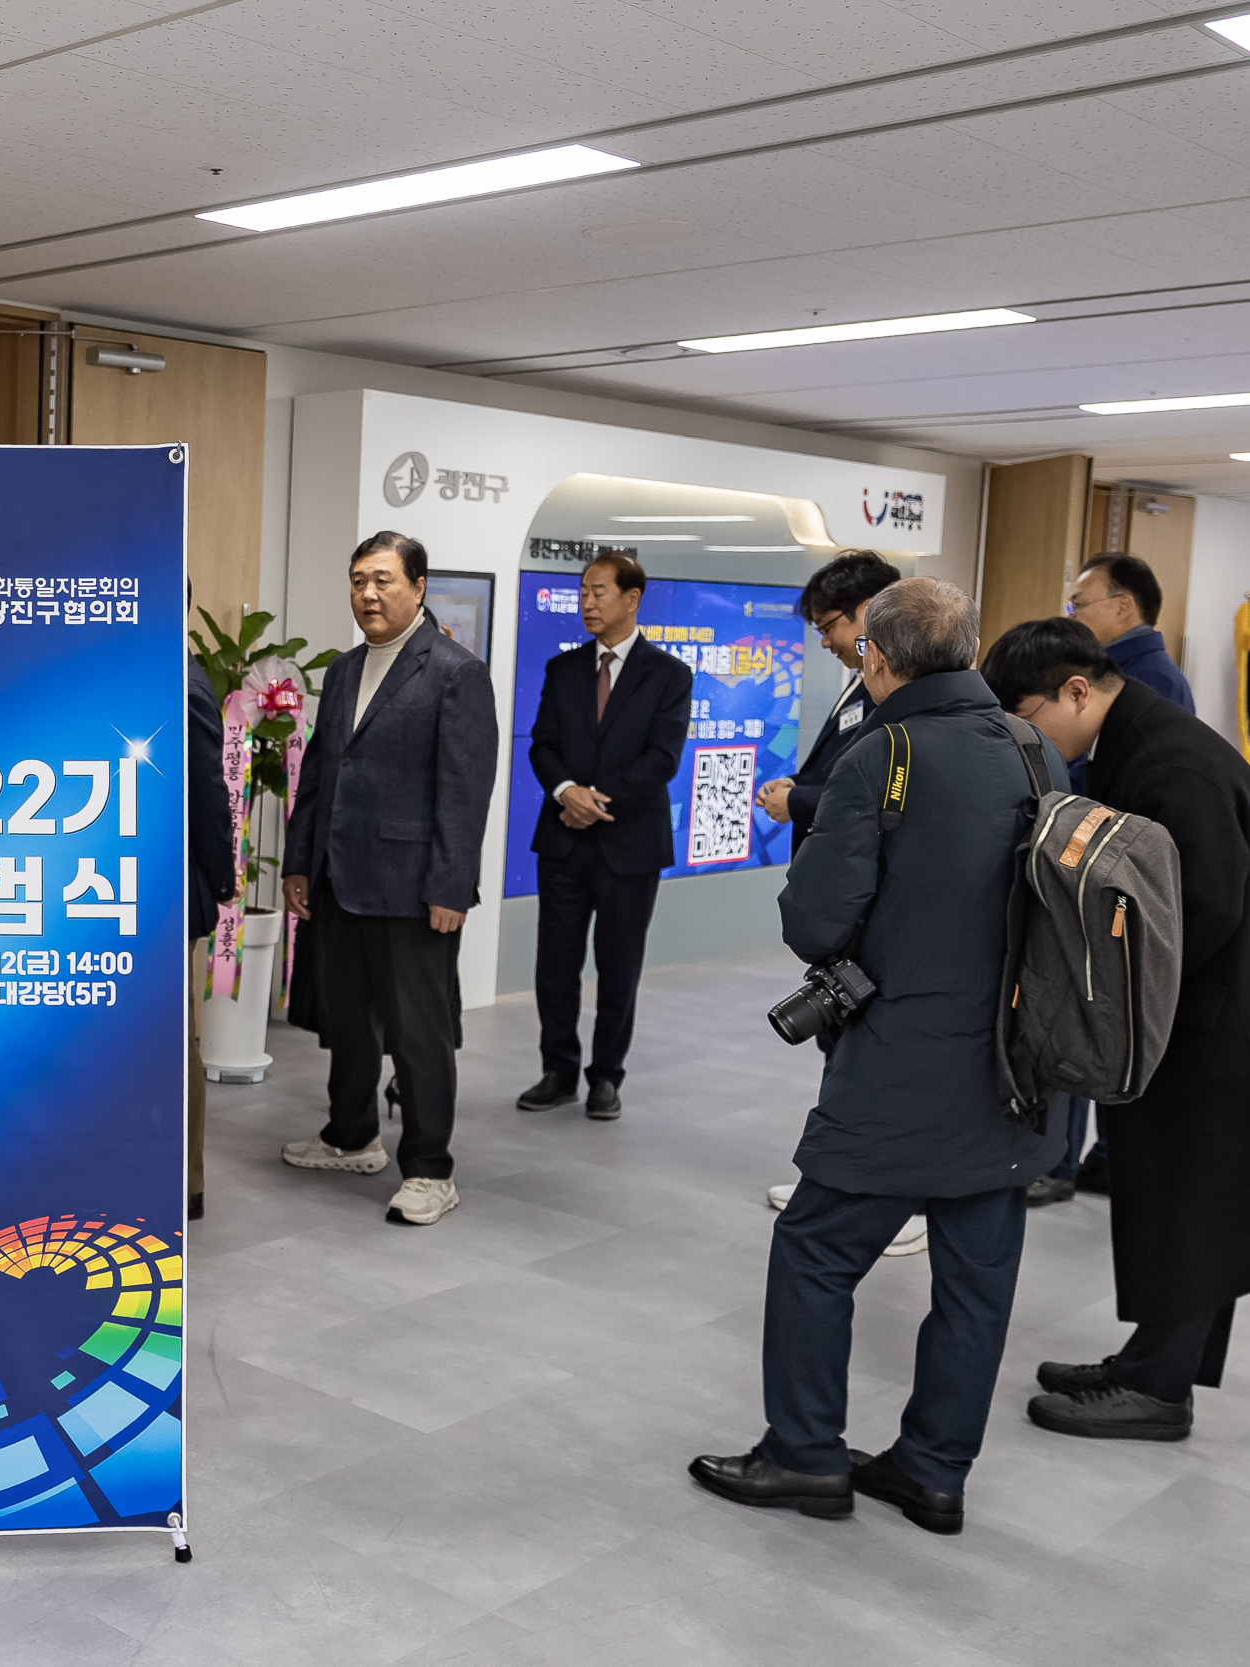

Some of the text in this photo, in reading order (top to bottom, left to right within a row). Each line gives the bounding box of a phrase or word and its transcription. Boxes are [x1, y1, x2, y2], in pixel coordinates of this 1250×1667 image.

[434, 468, 509, 504] 광진구
[890, 766, 905, 801] Nikon
[66, 951, 133, 974] 14:00
